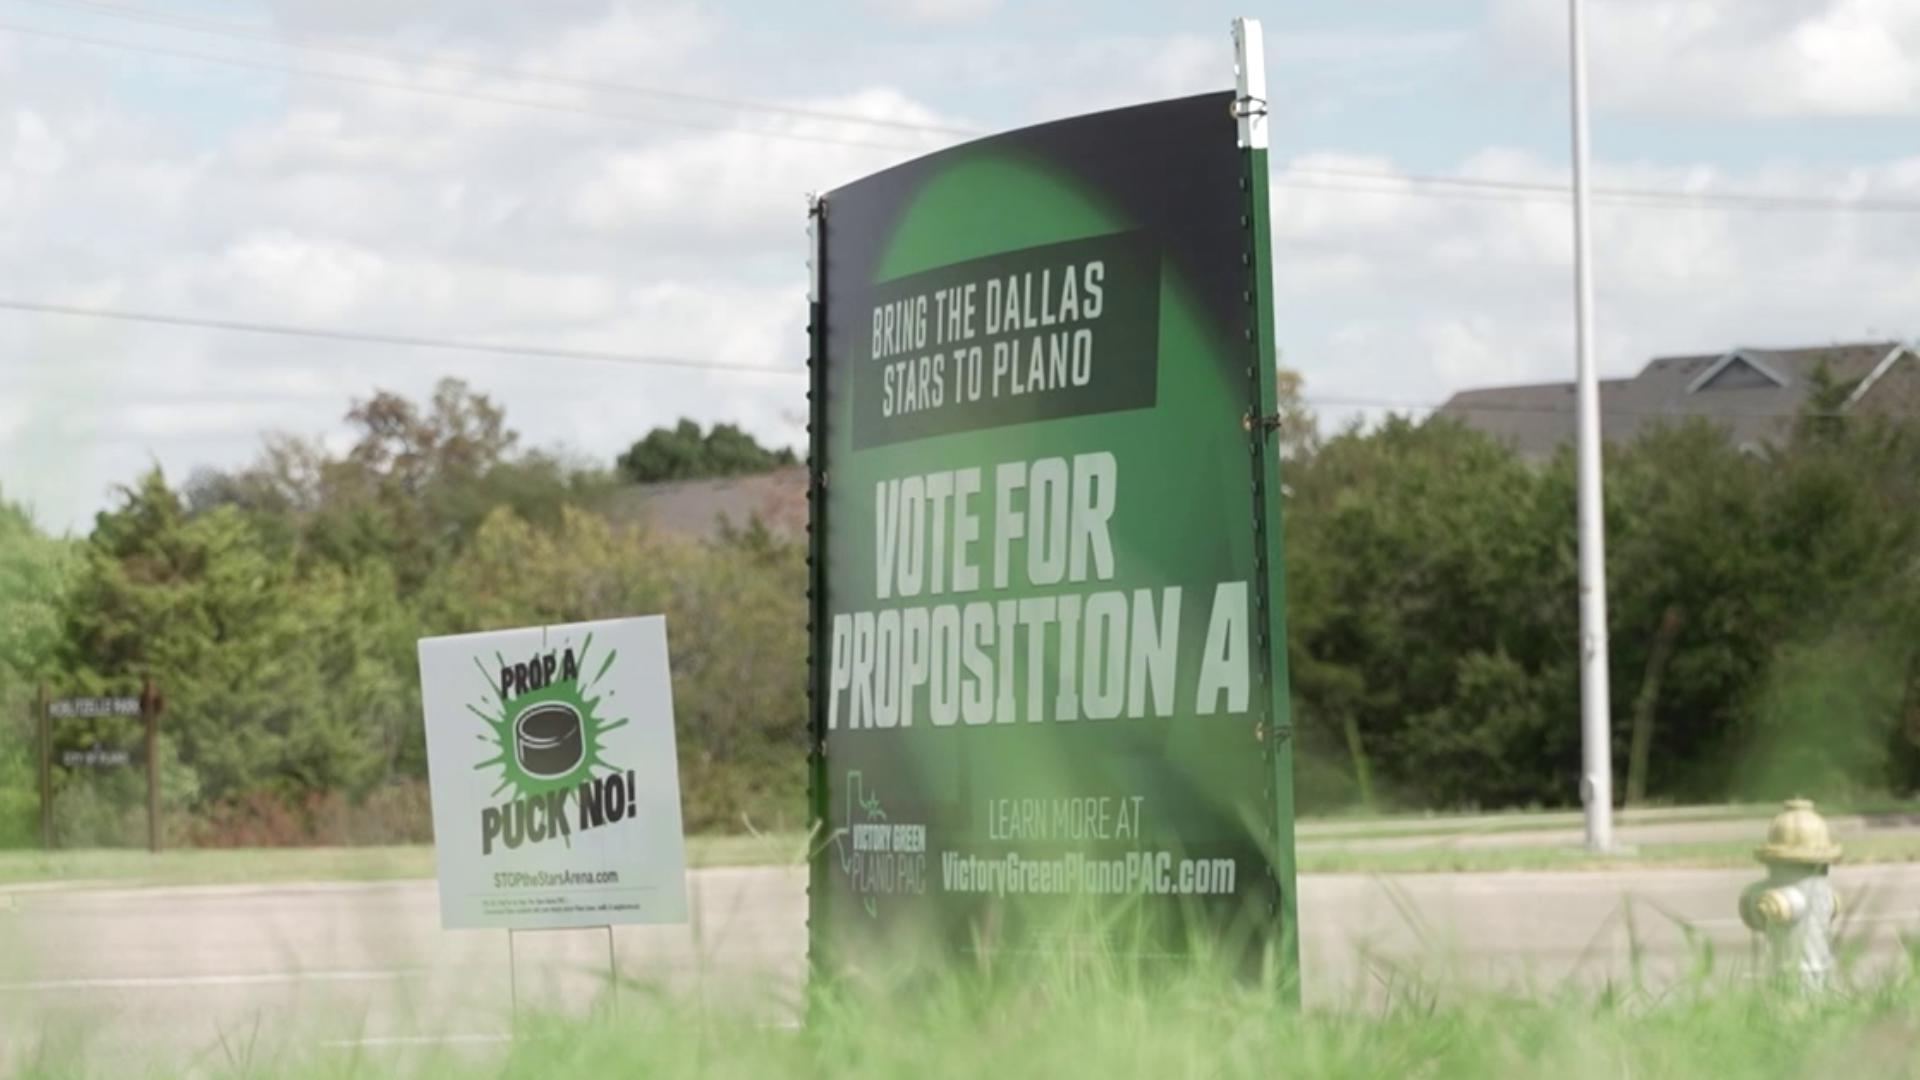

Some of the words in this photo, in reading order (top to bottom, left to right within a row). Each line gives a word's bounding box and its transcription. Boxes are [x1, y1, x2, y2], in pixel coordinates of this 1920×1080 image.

[872, 295, 928, 360] BRING
[935, 283, 976, 344] THE
[985, 260, 1105, 335] DALLAS
[882, 349, 945, 418] STARS
[953, 346, 983, 404] TO
[992, 329, 1092, 397] PLANO
[876, 467, 981, 599] VOTE
[994, 451, 1117, 589] FOR
[501, 654, 556, 699] PROP
[563, 648, 577, 681] A
[828, 586, 1182, 729] PROPOSITION
[1196, 581, 1249, 714] A
[481, 786, 570, 855] PUCK
[579, 769, 636, 830] NO!
[989, 799, 1047, 839] LEARN
[1050, 797, 1110, 839] MORE
[1115, 796, 1144, 839] AT
[853, 824, 892, 850] VICTORY
[893, 824, 926, 852] GREEN
[494, 869, 619, 888] STOPtheStarsArena.com
[852, 852, 894, 893] PLANO
[898, 853, 926, 894] PAC
[942, 851, 1236, 897] VictoryGreenPlanoPAC.com
